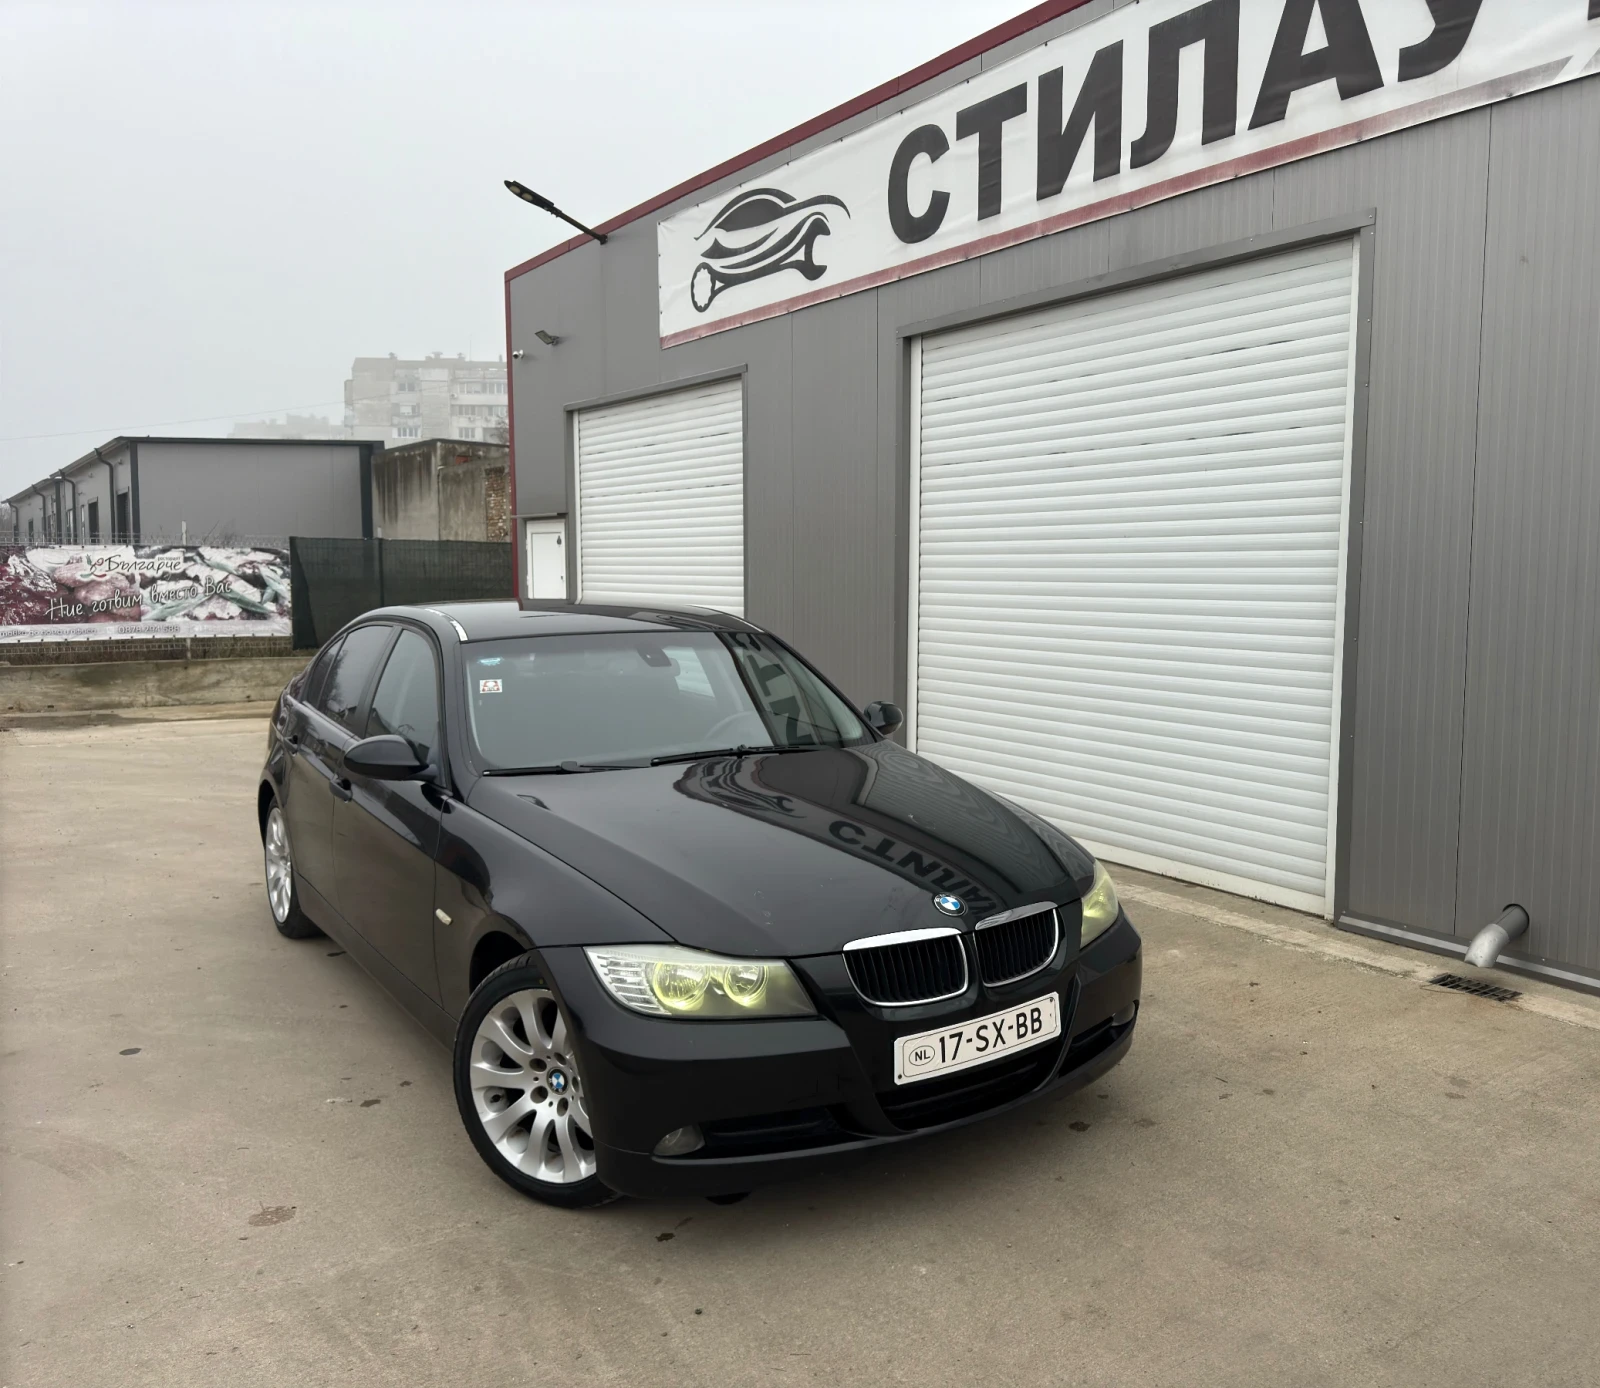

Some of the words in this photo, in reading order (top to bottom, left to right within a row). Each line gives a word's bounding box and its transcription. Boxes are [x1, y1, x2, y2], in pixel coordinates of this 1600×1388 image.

[887, 0, 1600, 243] СТИЛАУ
[104, 554, 182, 576] Българче
[45, 597, 84, 620] Ние
[91, 589, 143, 614] готвим
[150, 583, 198, 603] вместо
[205, 575, 232, 597] Вас
[914, 1049, 931, 1062] NL
[938, 1007, 1043, 1064] 17-SX-BB
